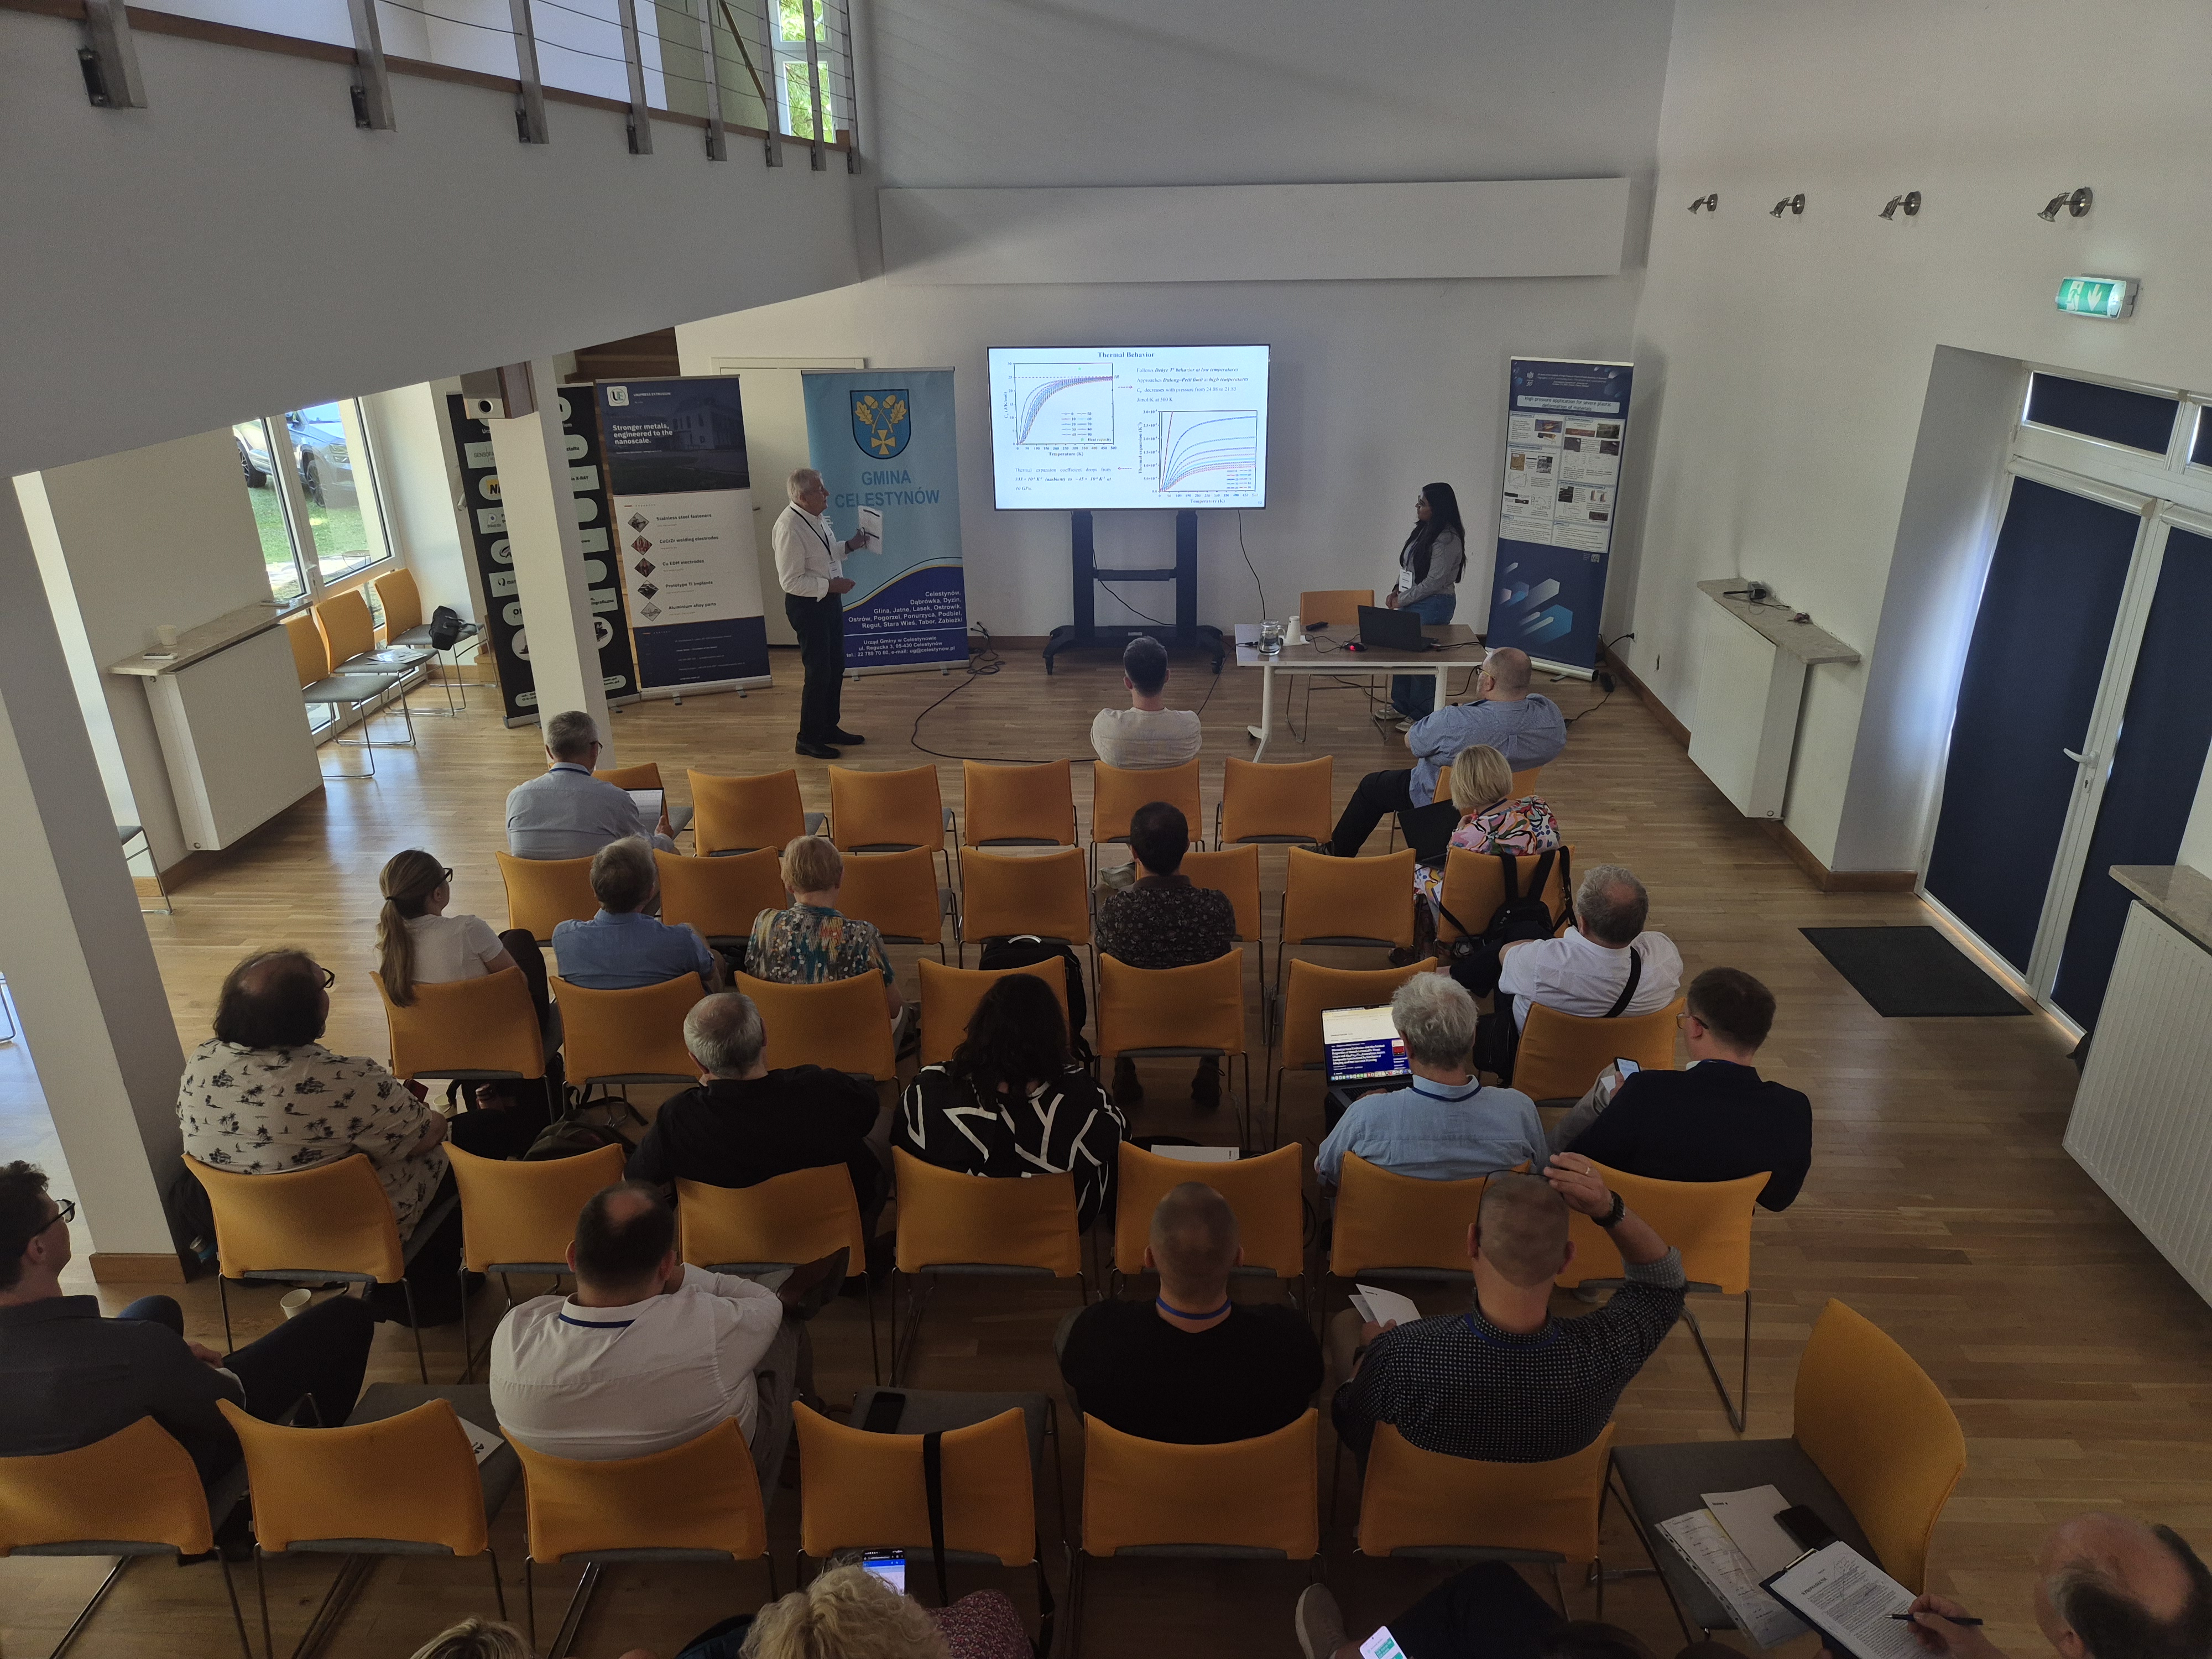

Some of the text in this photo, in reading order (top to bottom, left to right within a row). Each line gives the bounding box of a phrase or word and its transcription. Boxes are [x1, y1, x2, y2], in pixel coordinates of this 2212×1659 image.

[613, 430, 652, 439] engineered
[862, 469, 911, 486] GMINA
[835, 486, 940, 508] CELESTYNÓW
[909, 646, 955, 654] ug@celestynow.pl
